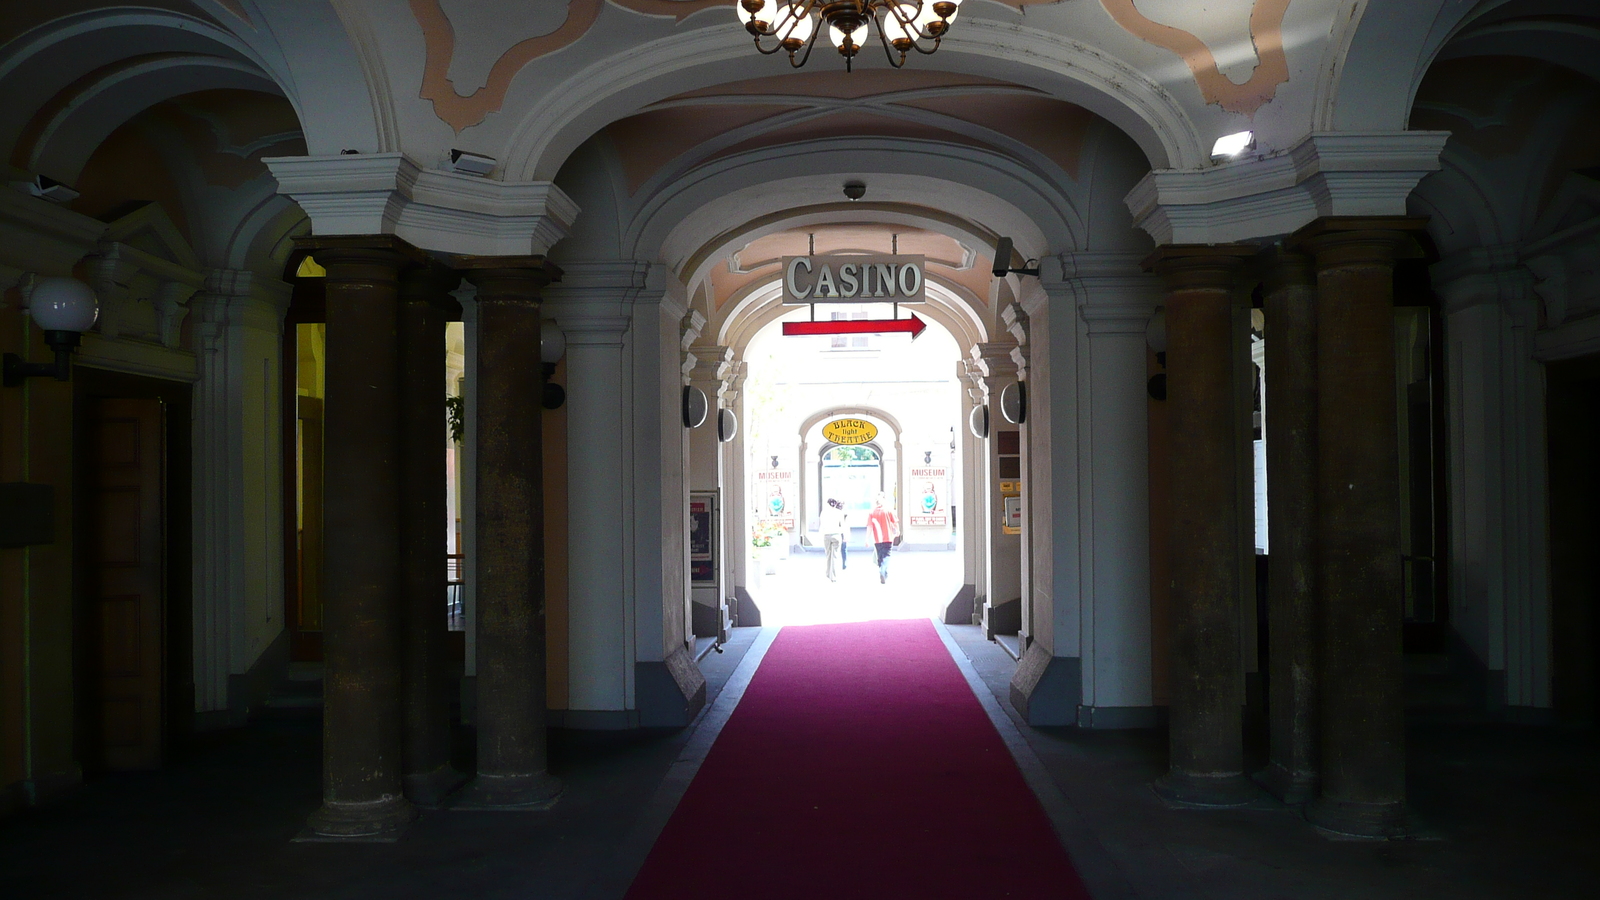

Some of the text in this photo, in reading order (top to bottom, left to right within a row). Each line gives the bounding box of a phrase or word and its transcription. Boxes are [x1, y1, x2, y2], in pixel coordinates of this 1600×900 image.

[786, 256, 921, 299] CASINO
[833, 420, 865, 429] BLACK
[828, 431, 872, 443] THEATRE
